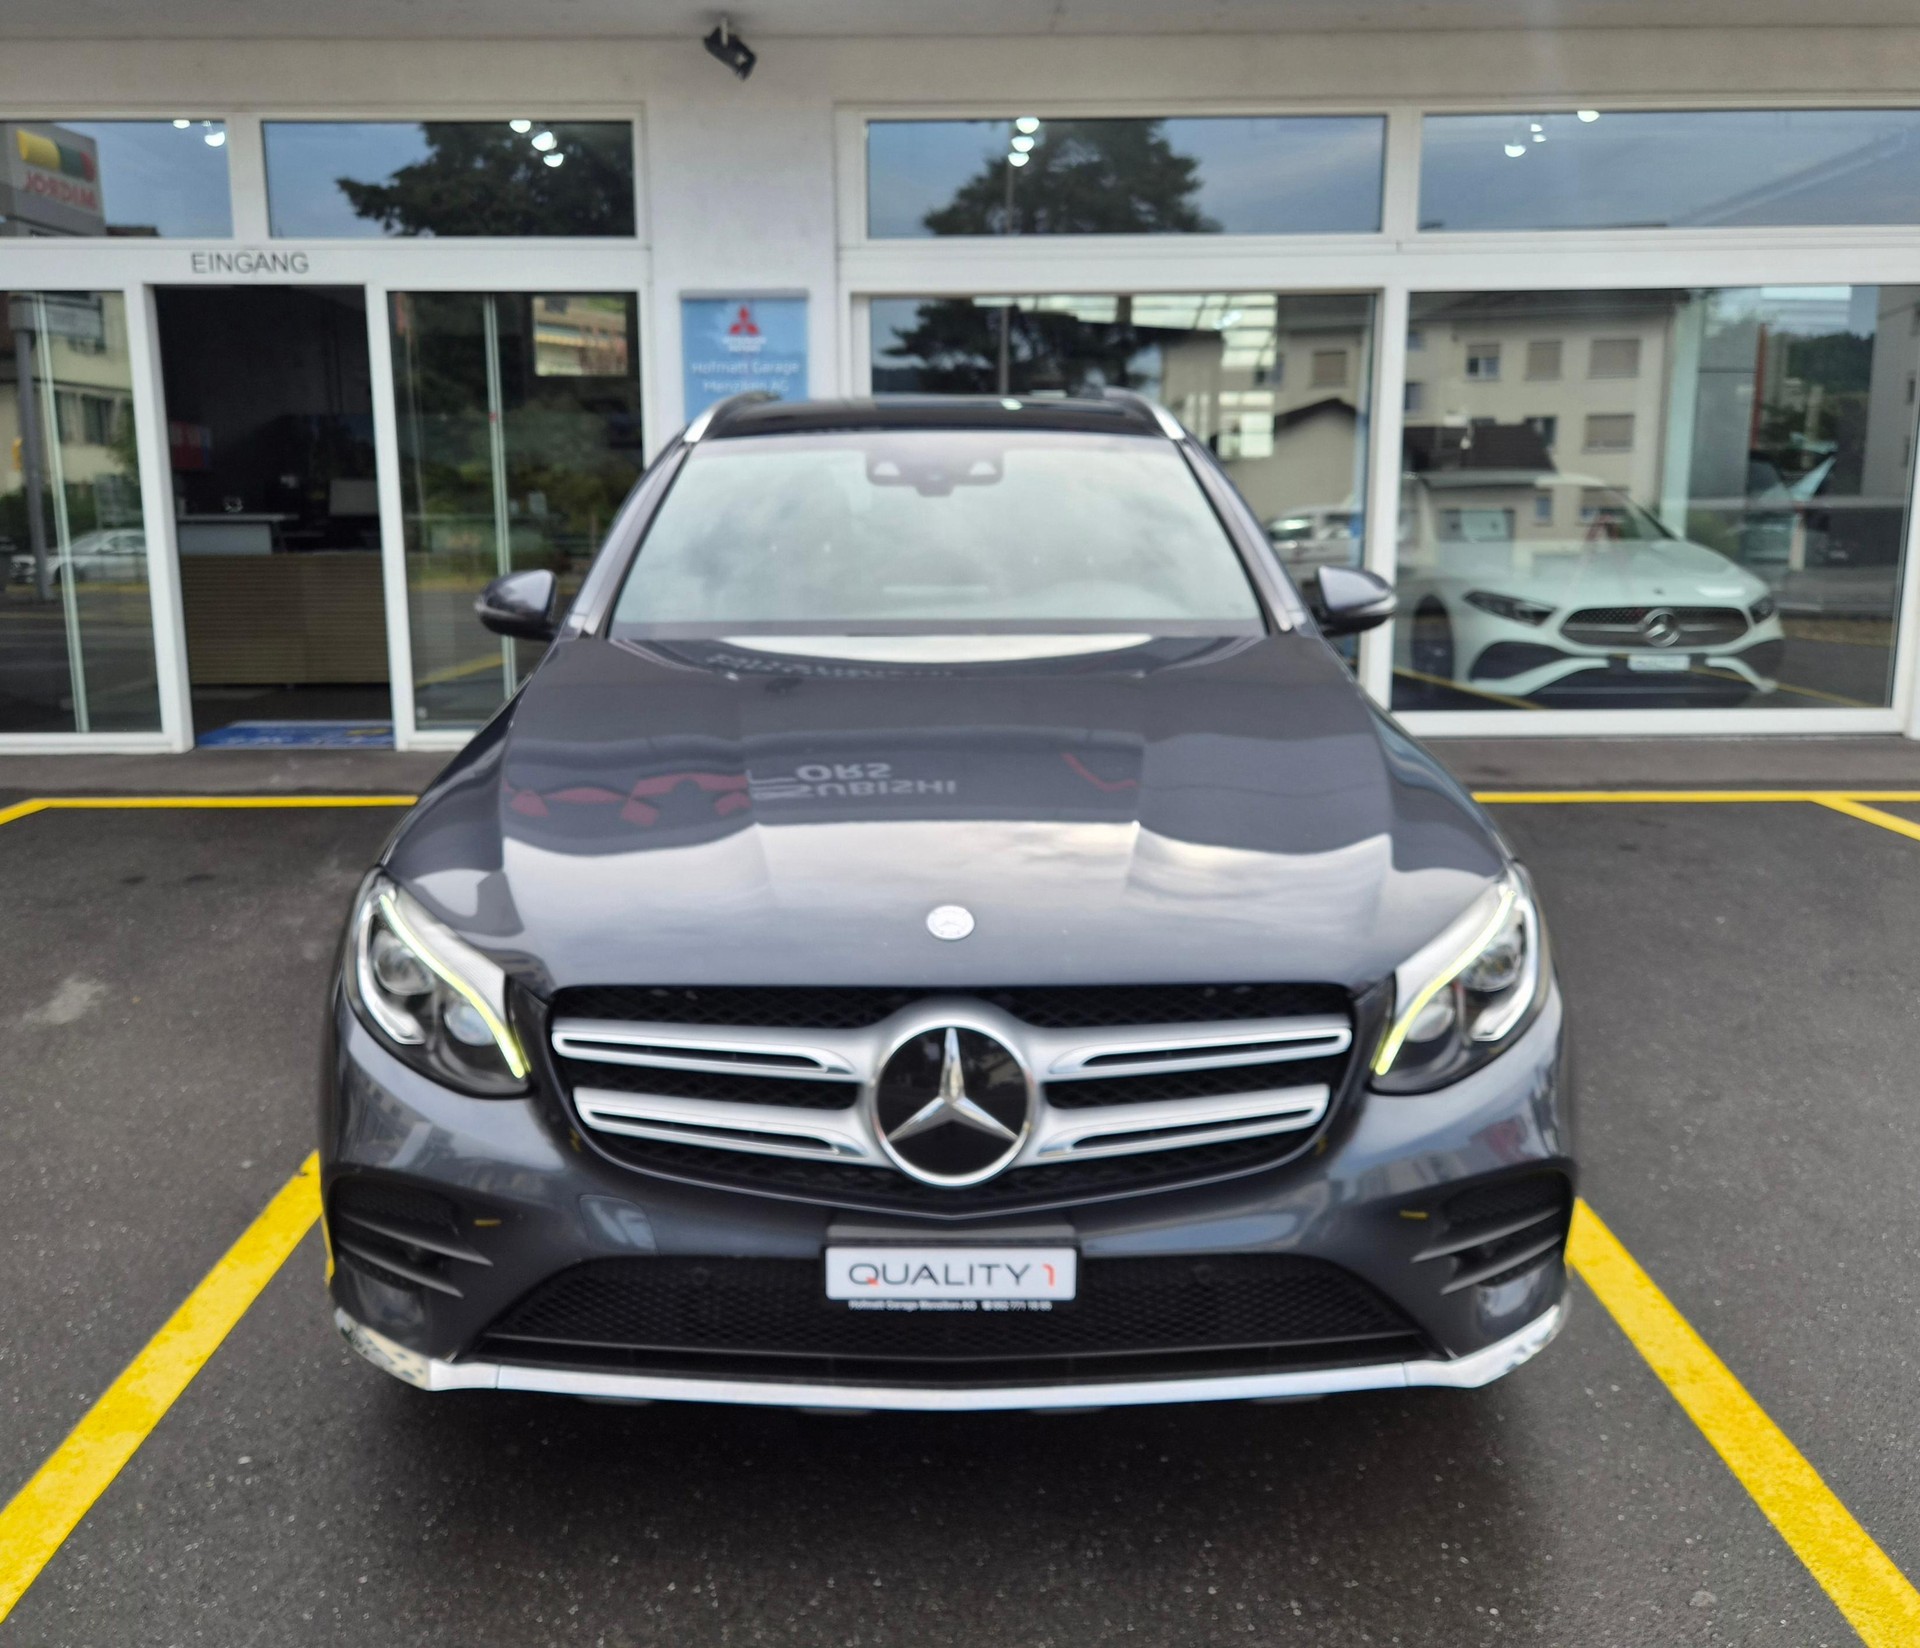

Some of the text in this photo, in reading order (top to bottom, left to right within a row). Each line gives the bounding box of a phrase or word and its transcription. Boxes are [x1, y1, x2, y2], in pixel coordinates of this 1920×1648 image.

[191, 252, 309, 274] EINGANG
[849, 1263, 1055, 1287] QUALITY 1
